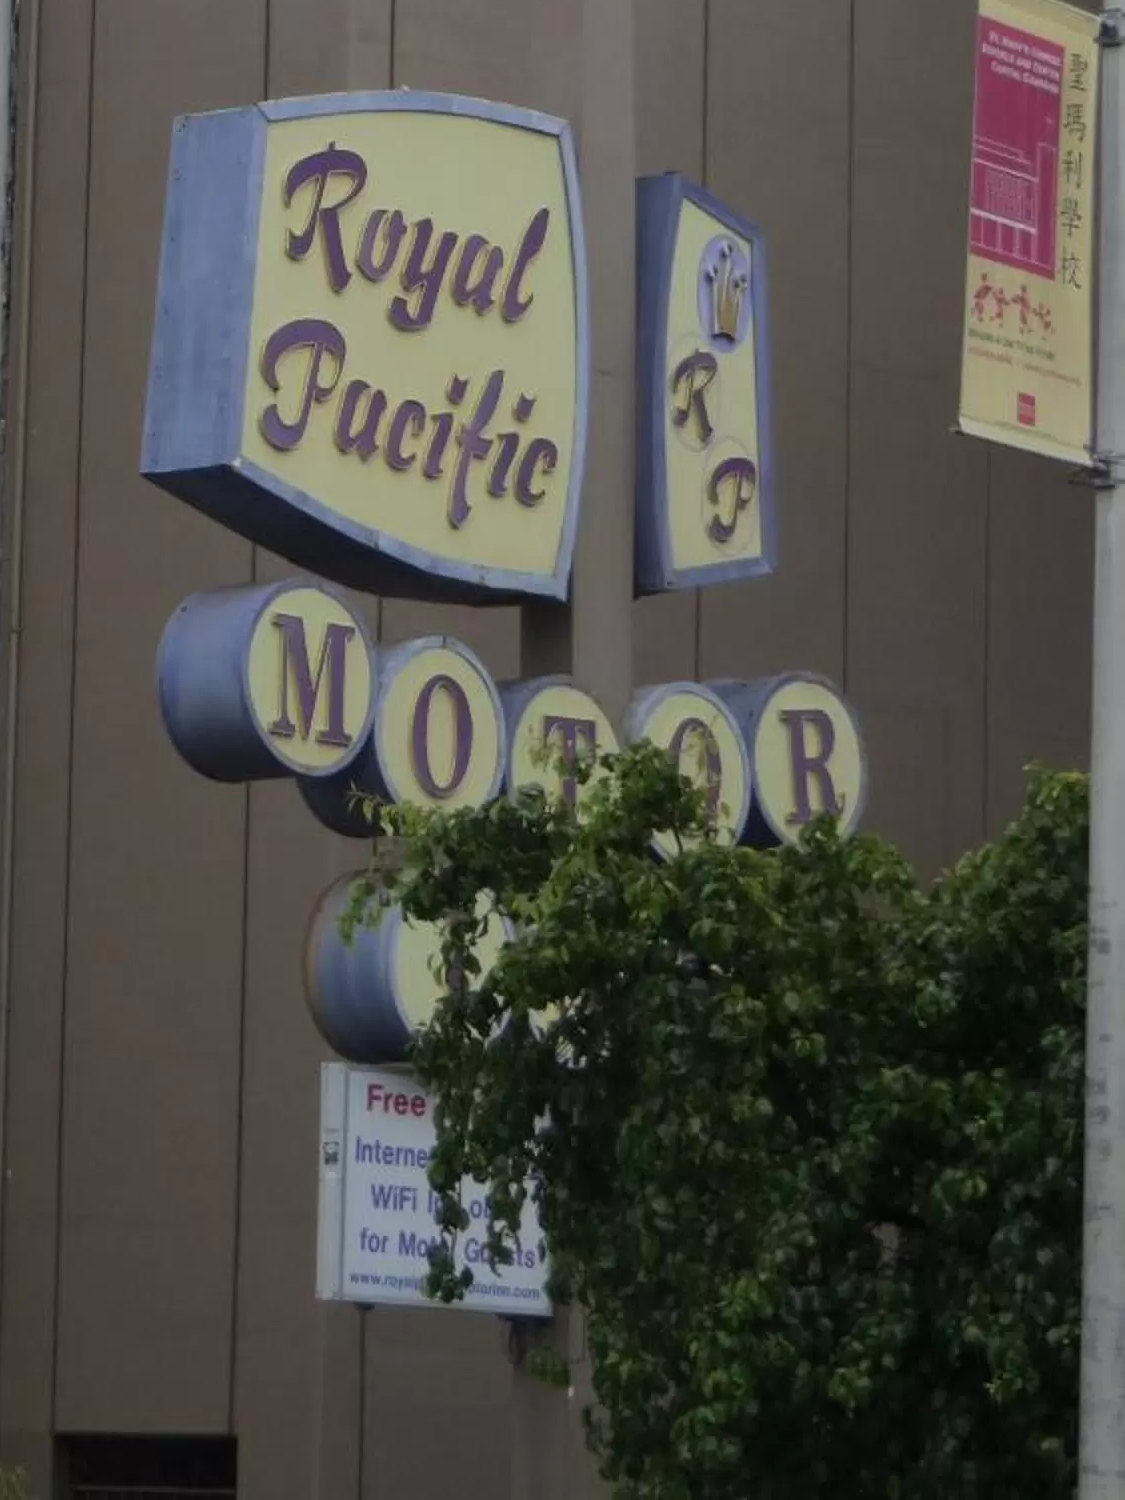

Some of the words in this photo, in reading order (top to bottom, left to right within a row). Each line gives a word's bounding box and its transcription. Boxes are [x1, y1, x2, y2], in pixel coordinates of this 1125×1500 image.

[283, 141, 550, 332] Royal
[258, 317, 559, 531] Pacific
[672, 348, 719, 444] R
[706, 455, 757, 544] P
[269, 612, 847, 827] MOTOR
[366, 1083, 427, 1117] Free
[355, 1135, 430, 1169] Interne
[359, 1227, 389, 1253] for
[371, 1184, 418, 1214] WiFi
